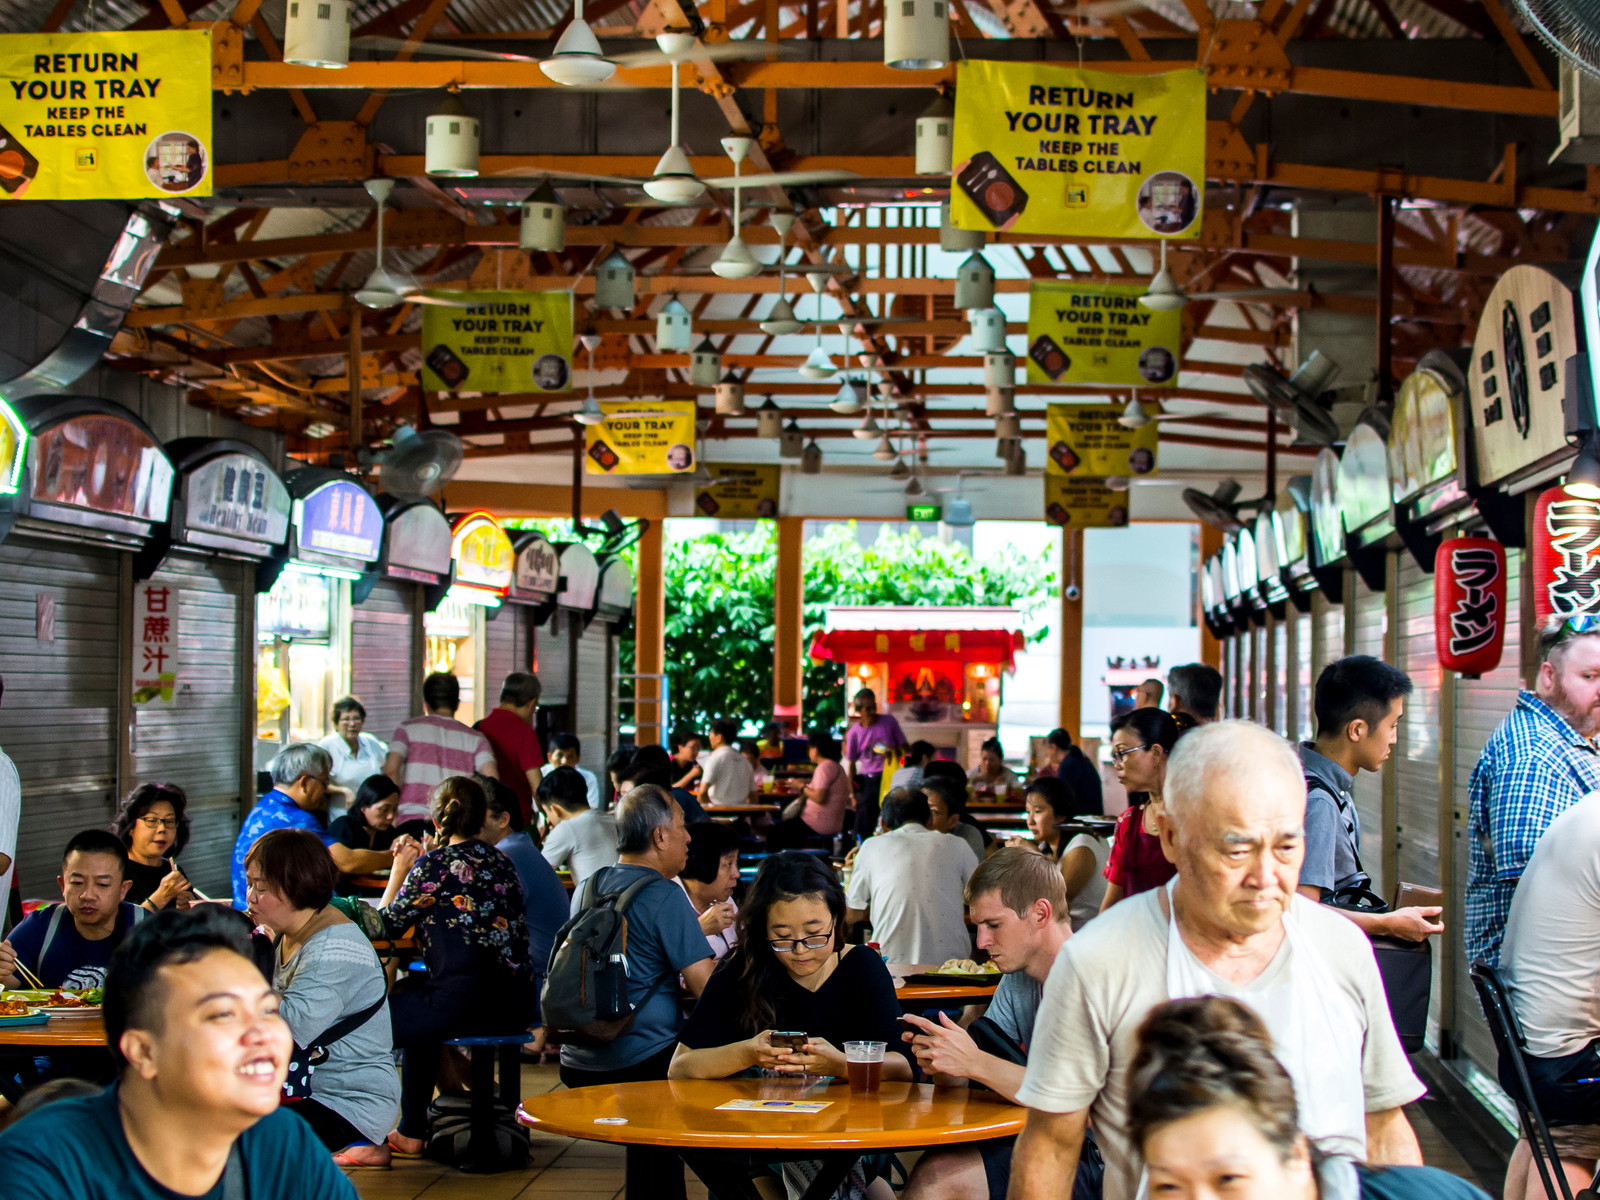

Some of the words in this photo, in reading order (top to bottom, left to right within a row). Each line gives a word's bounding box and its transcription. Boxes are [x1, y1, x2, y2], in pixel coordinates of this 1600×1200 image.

[34, 53, 138, 73] RETURN
[10, 80, 86, 100] YOUR
[94, 78, 161, 98] TRAY
[1029, 85, 1133, 109] RETURN
[47, 107, 90, 120] KEEP
[94, 106, 125, 118] THE
[24, 125, 86, 137] TABLES
[92, 123, 146, 136] CLEAN
[1004, 111, 1079, 134] YOUR
[1087, 114, 1157, 136] TRAY
[1040, 140, 1082, 155] KEEP
[1088, 142, 1119, 156] THE
[1015, 157, 1078, 173] TABLES
[1083, 160, 1141, 175] CLEAN
[1071, 295, 1137, 309] RETURN
[452, 319, 497, 332] YOUR
[502, 320, 543, 332] TRAY
[1056, 310, 1103, 323] YOUR
[1108, 312, 1151, 326] TRAY
[607, 422, 640, 431] YOUR
[644, 421, 674, 430] TRAY
[914, 508, 933, 519] EXIT
[1449, 547, 1499, 656] ラーメン
[143, 585, 170, 674] 甘蔗汁
